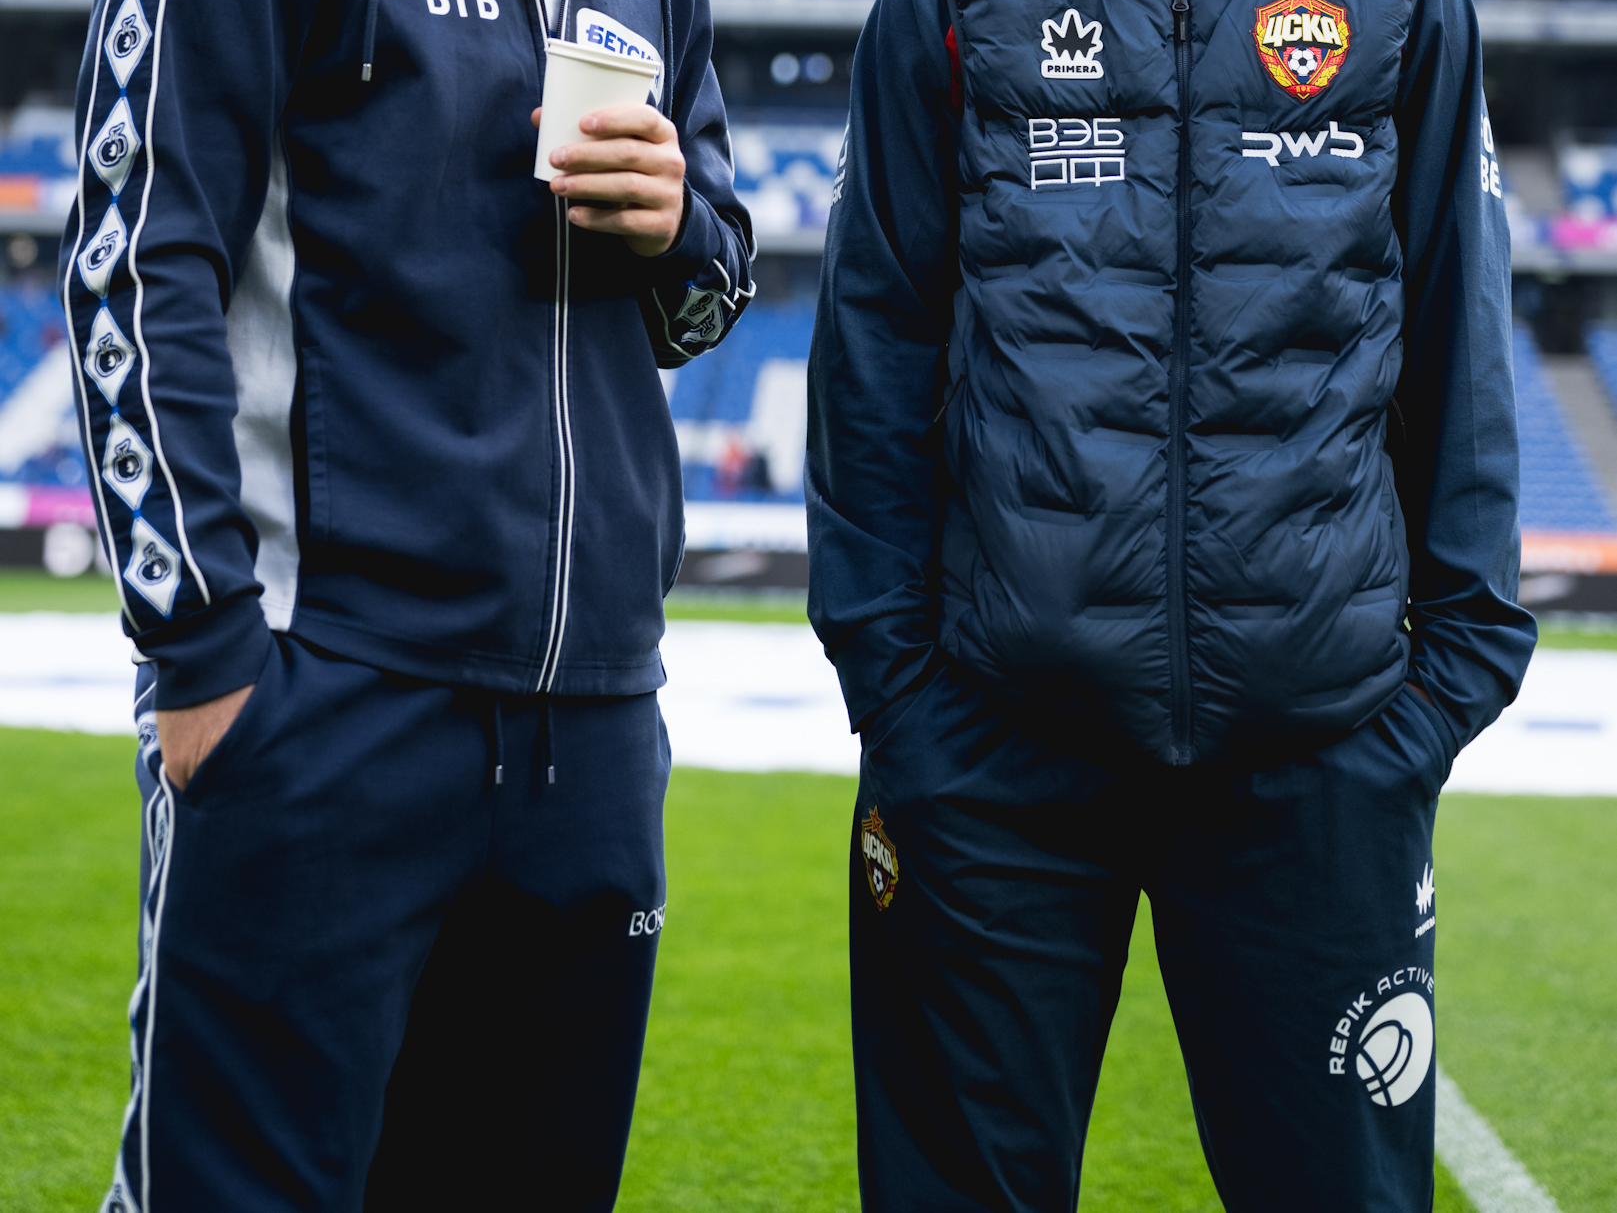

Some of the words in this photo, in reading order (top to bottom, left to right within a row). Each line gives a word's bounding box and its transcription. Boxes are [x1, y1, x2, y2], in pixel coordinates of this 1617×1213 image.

[1262, 13, 1343, 48] ЦСКА
[1047, 64, 1098, 74] PRIMERA
[1028, 118, 1124, 149] ВЭБ
[863, 831, 895, 878] ЦСКА
[1329, 991, 1373, 1075] REPIK
[1376, 966, 1435, 995] ACTIVE
